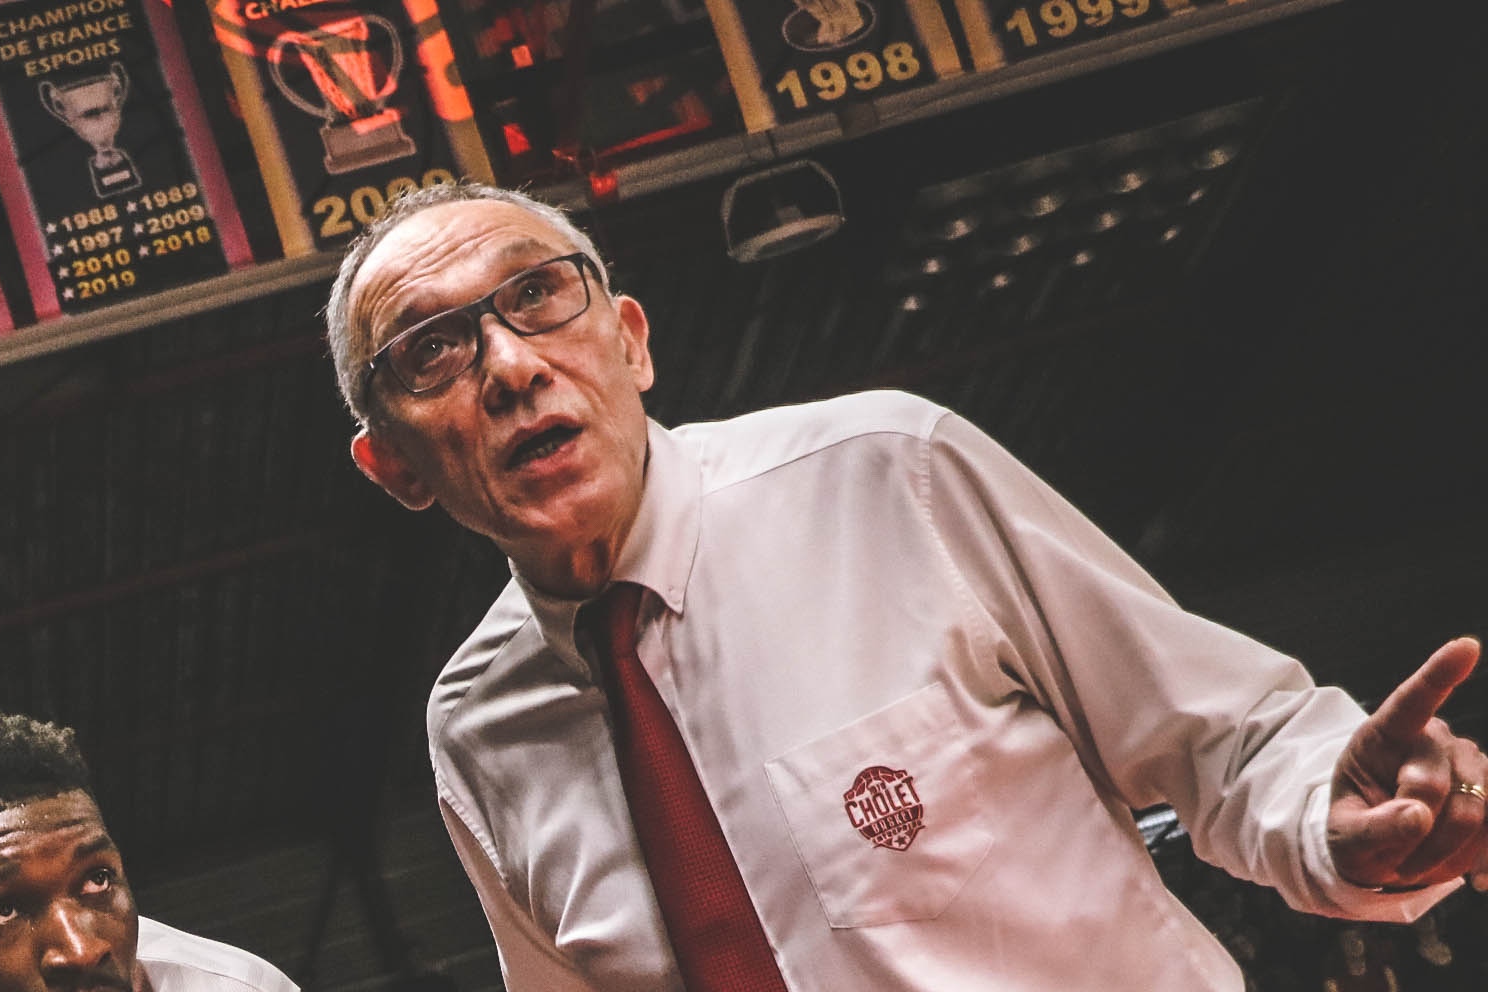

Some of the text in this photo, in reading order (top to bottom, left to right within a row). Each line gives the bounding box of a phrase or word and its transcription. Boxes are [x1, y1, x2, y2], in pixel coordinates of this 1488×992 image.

[0, 13, 133, 62] DE FRANCE
[24, 38, 121, 78] ESPOIRS
[776, 41, 921, 108] 1998
[139, 183, 197, 211] 1989
[68, 205, 205, 254] 1997 2009
[72, 226, 211, 277] 2010 2018
[78, 270, 136, 299] 2019
[845, 776, 920, 828] CHOLET
